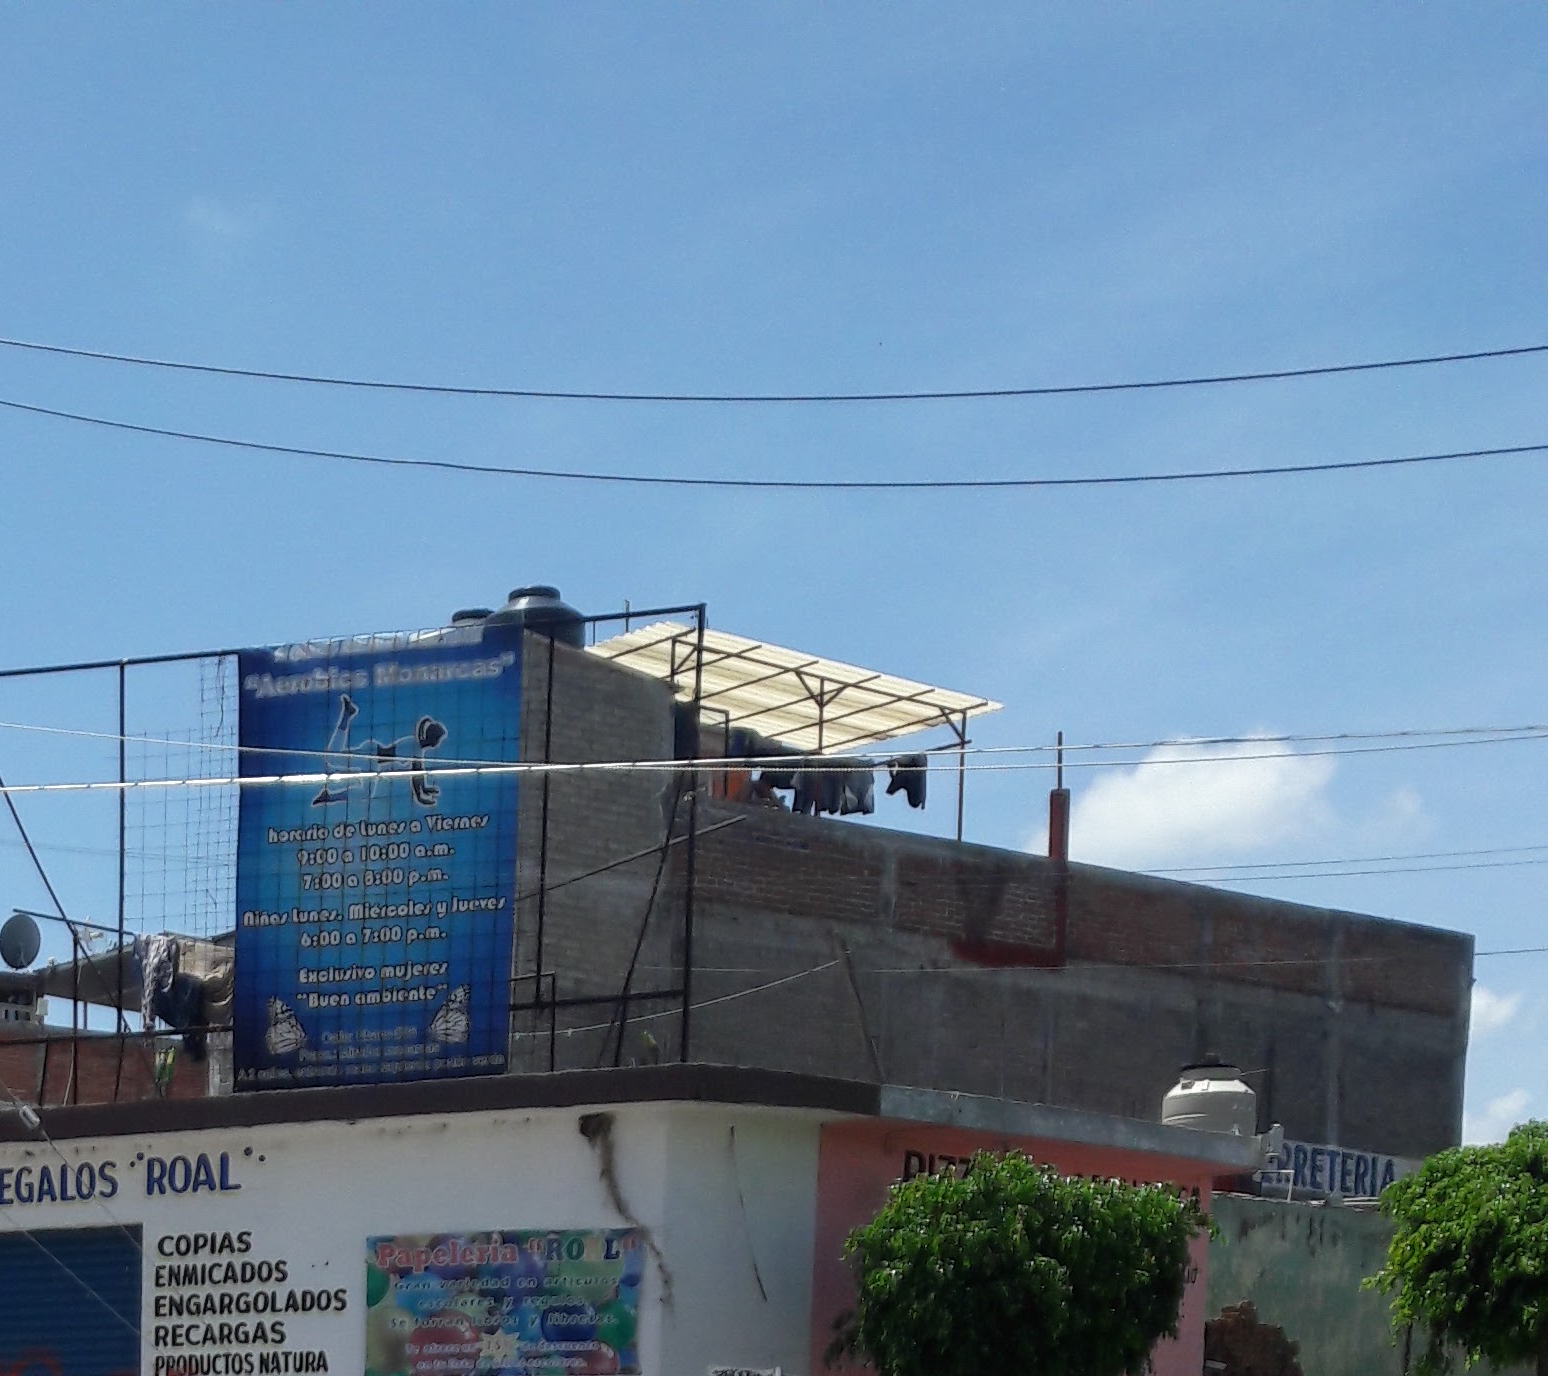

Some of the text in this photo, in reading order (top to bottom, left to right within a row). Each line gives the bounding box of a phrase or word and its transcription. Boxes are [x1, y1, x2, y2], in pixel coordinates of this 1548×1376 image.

[425, 814, 490, 832] Viernes
[297, 842, 456, 866] 9:00 a 10:00 a.m.
[303, 872, 342, 890] 7:00
[346, 875, 358, 888] a
[408, 868, 450, 888] p.m.
[437, 902, 447, 919] y
[451, 896, 508, 913] Jueves
[301, 925, 447, 948] 6:00 a 7:00 p.m.
[298, 959, 450, 985] Exclusivo mujeres
[157, 1230, 252, 1257] COPIAS
[154, 1259, 289, 1288] ENMICADOS
[154, 1287, 348, 1318] ENGARGOLADOS
[154, 1320, 286, 1348] RECARGAS
[258, 1350, 329, 1376] NATURA
